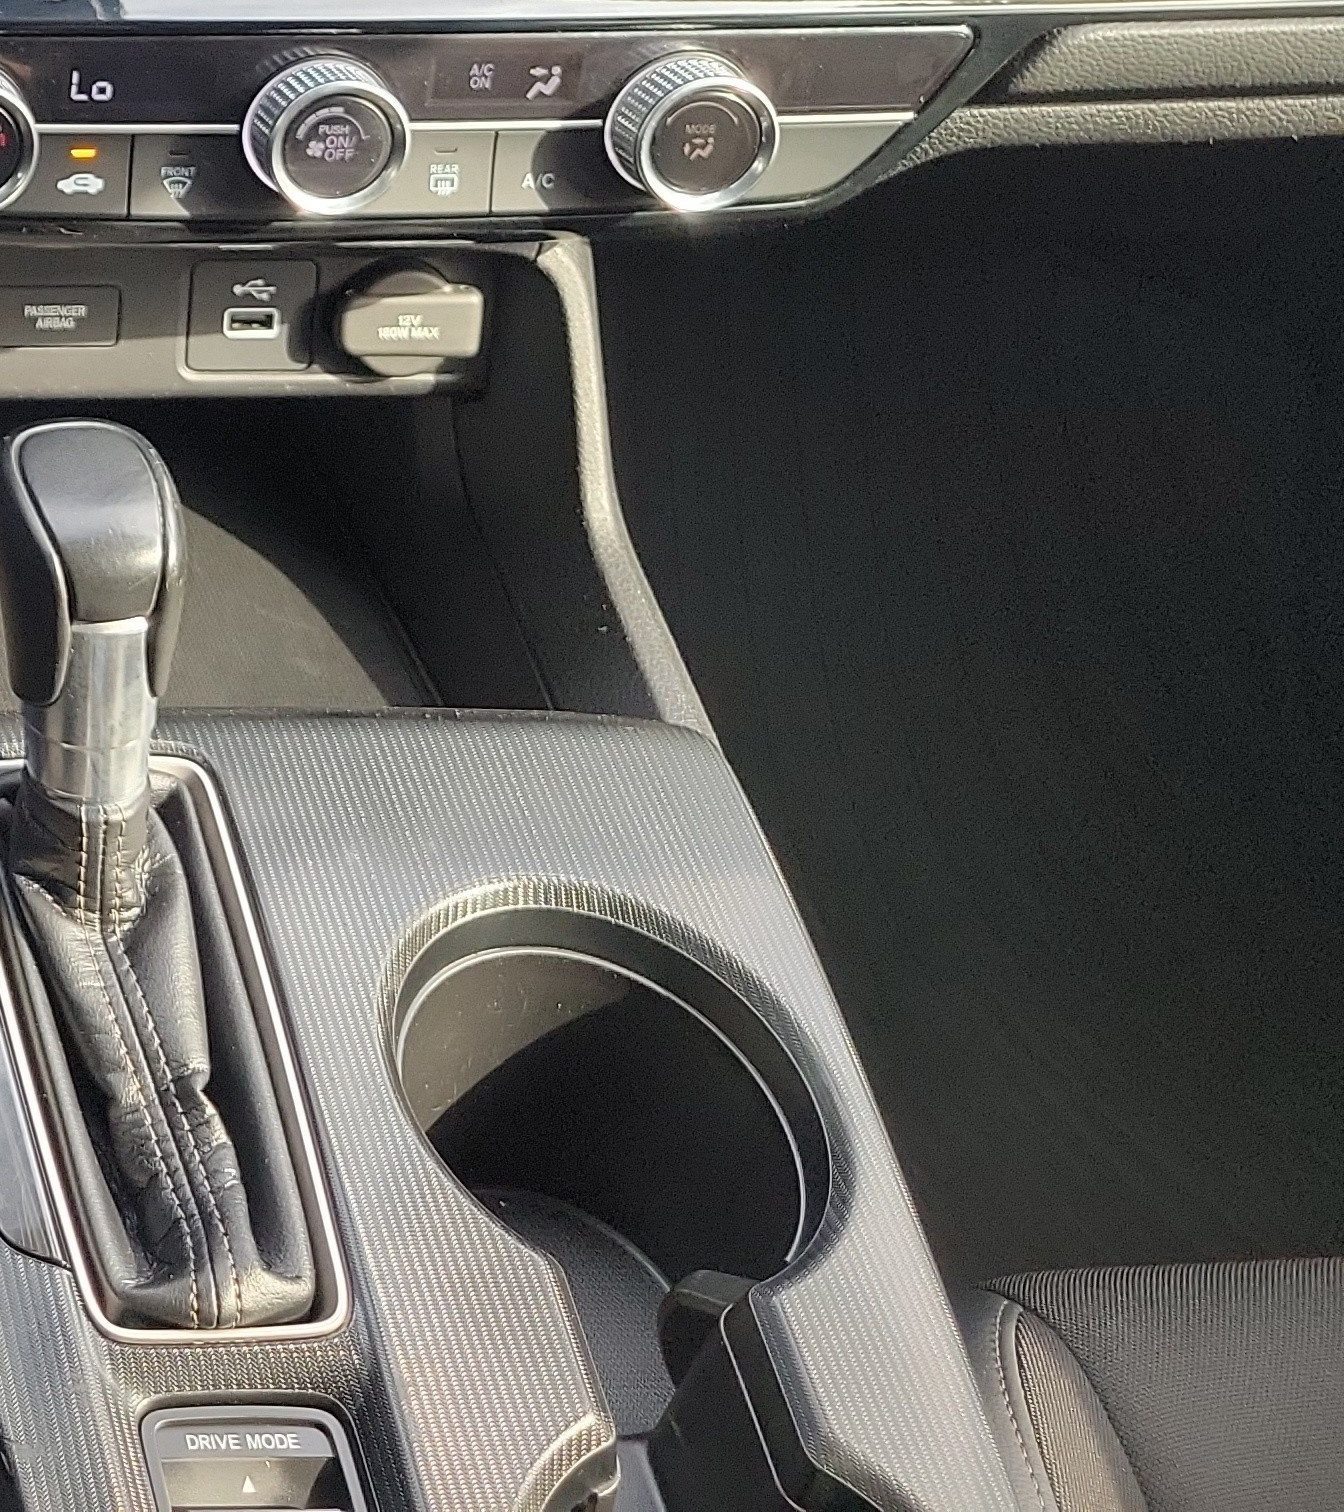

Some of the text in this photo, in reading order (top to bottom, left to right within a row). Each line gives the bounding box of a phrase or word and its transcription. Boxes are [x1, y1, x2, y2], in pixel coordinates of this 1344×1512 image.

[468, 62, 494, 76] A/C
[69, 69, 114, 103] Lo
[469, 76, 492, 90] ON
[318, 124, 349, 135] PUSH
[685, 123, 717, 135] MODE
[325, 135, 356, 149] ON/
[323, 149, 355, 162] OFF
[160, 166, 197, 178] FRONT
[429, 164, 460, 174] REAR
[521, 172, 556, 188] A/C
[24, 304, 88, 317] PASSENGER
[35, 317, 76, 329] AIRBAG
[397, 314, 423, 327] 12V
[185, 1433, 301, 1450] DRIVE MODE
